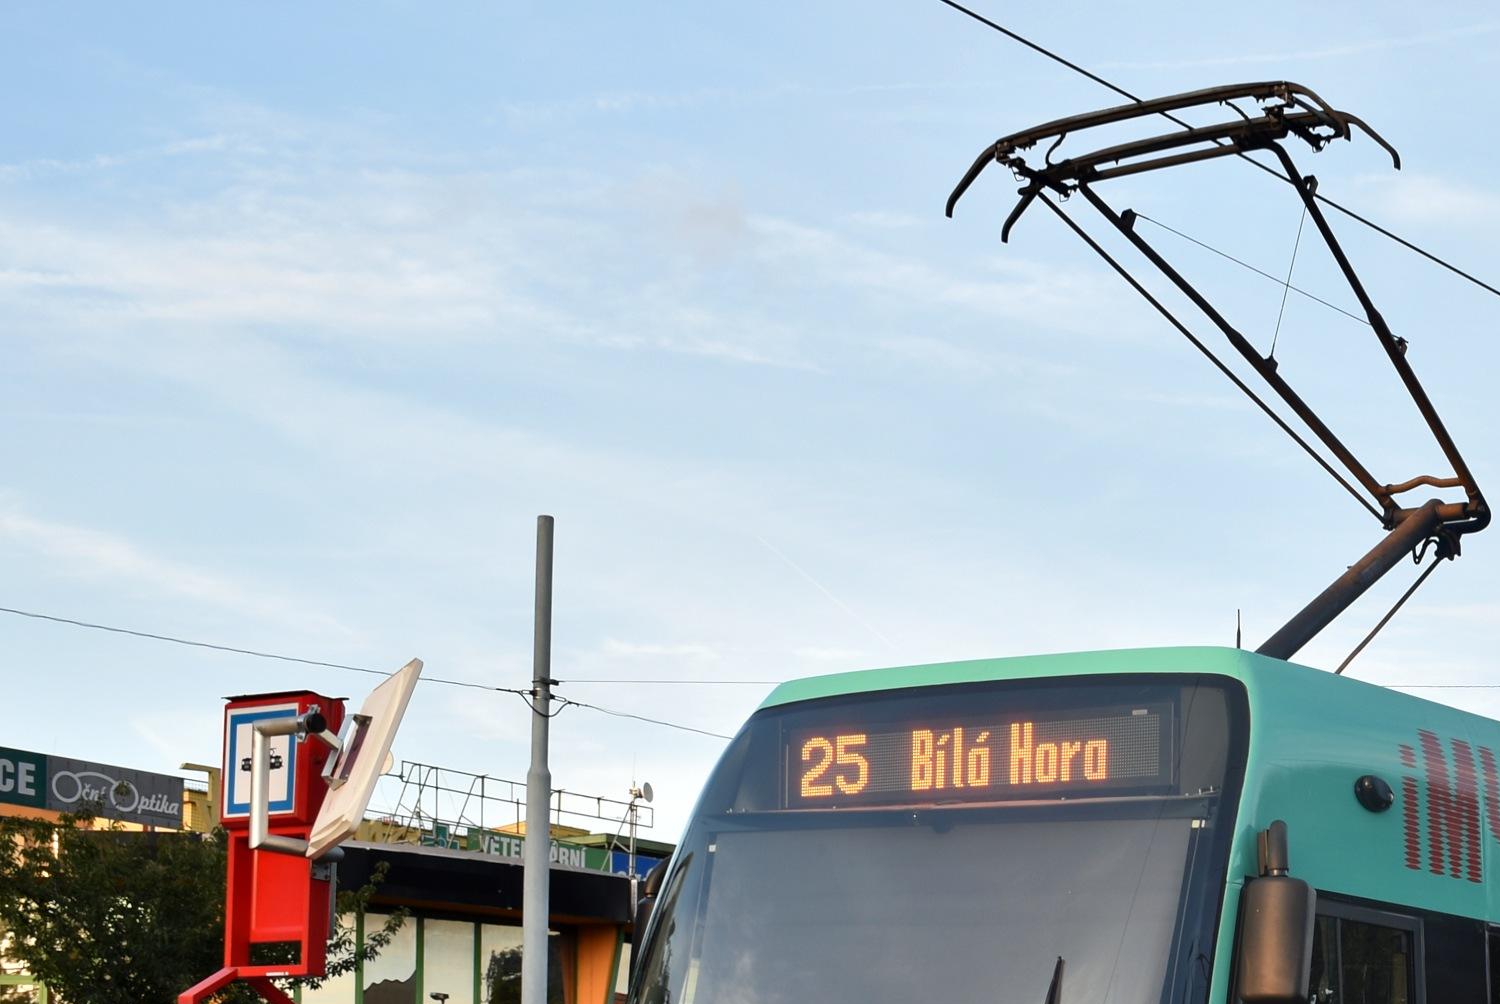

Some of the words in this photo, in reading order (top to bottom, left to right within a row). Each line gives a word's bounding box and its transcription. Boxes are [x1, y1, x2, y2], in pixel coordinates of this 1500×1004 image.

[800, 733, 869, 798] 25
[911, 726, 990, 791] Bílá
[1009, 720, 1108, 785] Hora
[109, 779, 180, 815] Optika
[482, 834, 587, 869] VETEÁRNÍ
